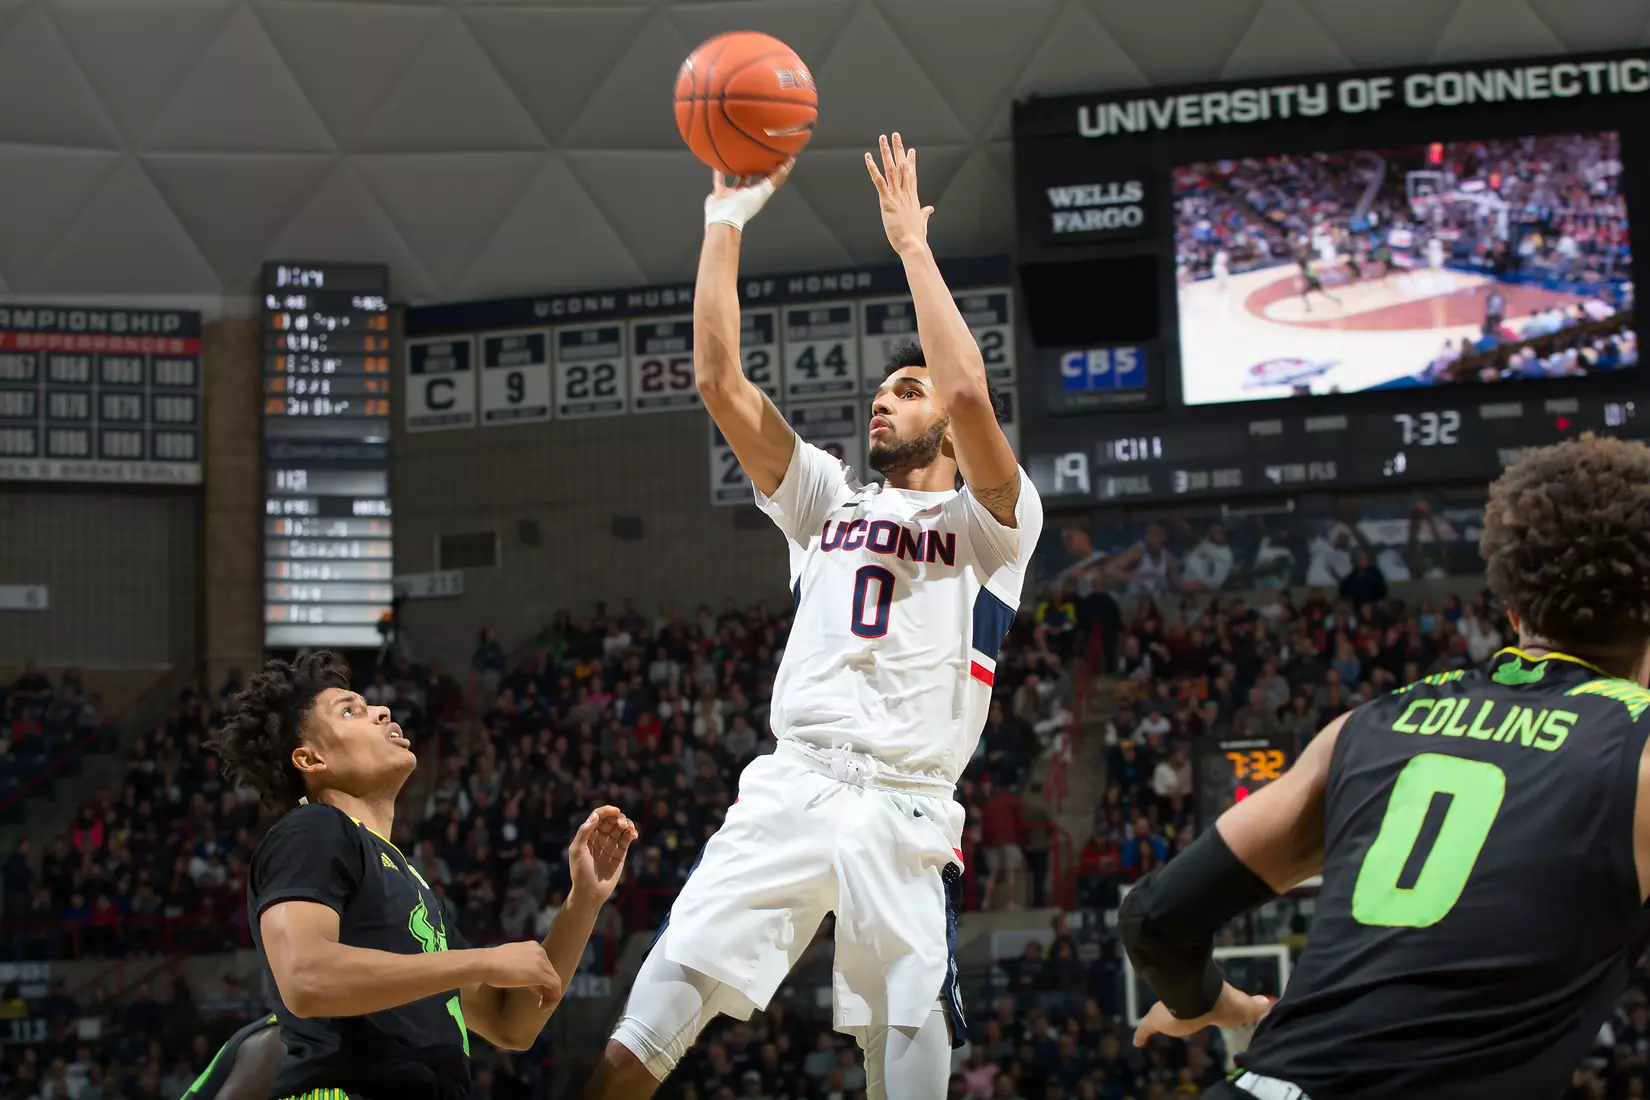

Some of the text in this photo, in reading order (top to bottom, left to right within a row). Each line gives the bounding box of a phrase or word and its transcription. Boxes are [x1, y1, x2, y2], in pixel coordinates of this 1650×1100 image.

[1077, 58, 1650, 138] UNIVERSITY OF CONNECTIC
[1047, 181, 1143, 208] WELLS
[1051, 205, 1144, 233] FARGO
[533, 296, 616, 317] UCONN
[745, 281, 775, 299] OF
[789, 272, 872, 294] HONOR
[641, 358, 694, 392] 25
[795, 343, 847, 378] 44
[1060, 347, 1138, 378] CBS
[425, 378, 455, 410] C
[507, 371, 526, 404] 9
[566, 365, 616, 399] 22
[1392, 410, 1461, 446] 7:32
[820, 518, 956, 567] UCONN
[850, 565, 896, 639] 0
[1391, 697, 1579, 752] COLLINS
[1226, 750, 1285, 780] 7:32
[1352, 753, 1507, 928] 0
